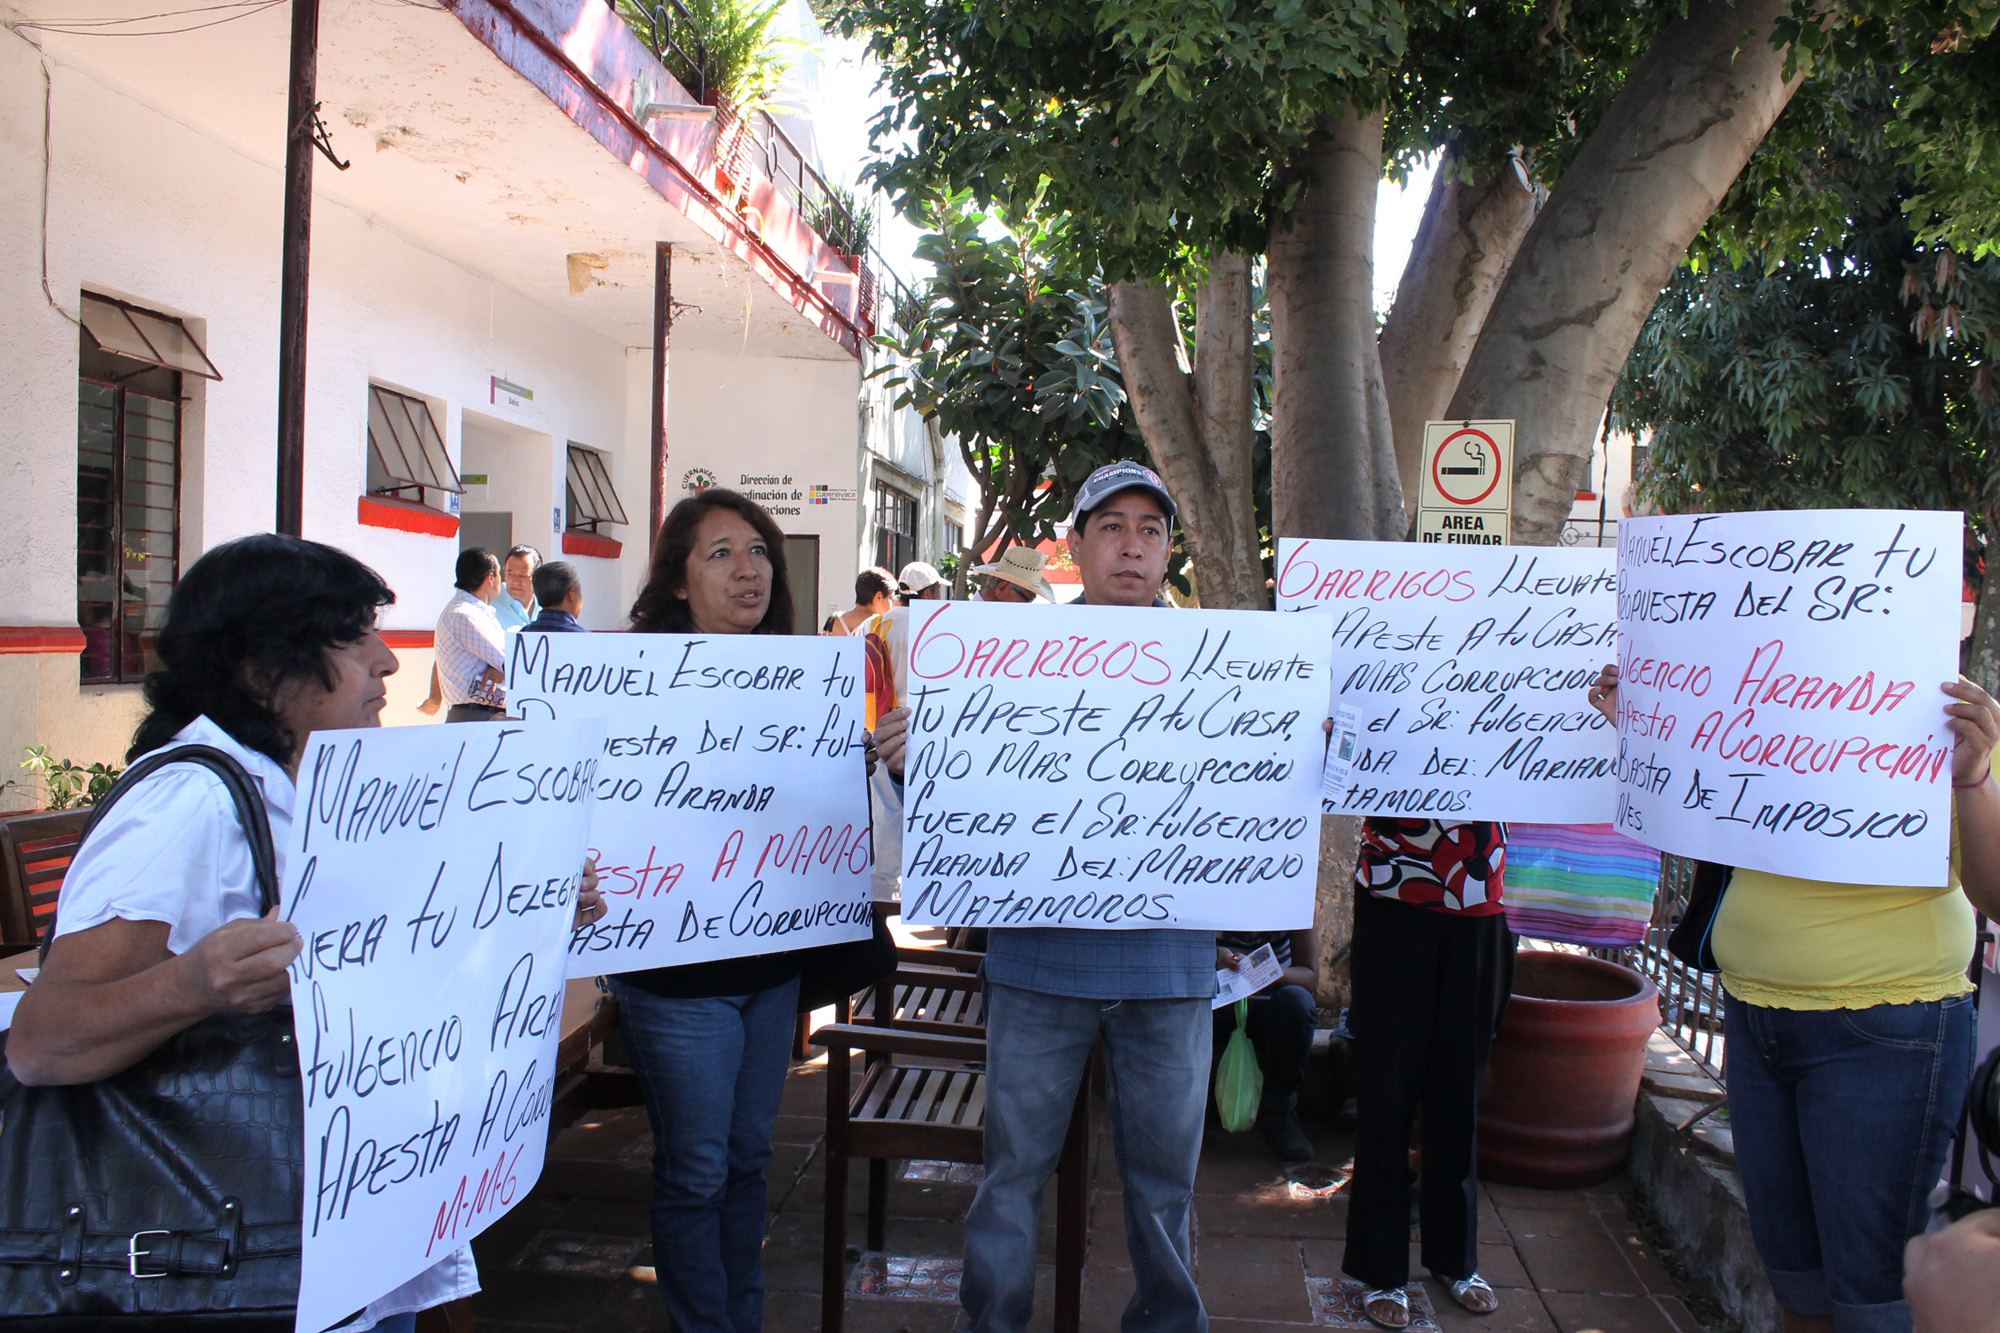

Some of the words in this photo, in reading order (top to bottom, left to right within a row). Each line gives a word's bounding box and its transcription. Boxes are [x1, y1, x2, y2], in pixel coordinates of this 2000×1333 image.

[682, 467, 718, 490] CUERNAVACA
[740, 474, 779, 485] Dirección
[782, 475, 792, 485] de
[791, 489, 803, 500] de
[1423, 532, 1442, 543] DE
[1447, 533, 1503, 546] FUMAR
[1442, 515, 1484, 531] AREA
[1674, 516, 1855, 574] ESCOBAR
[1278, 540, 1476, 602] GARRIGOS
[1617, 568, 1717, 624] PROPUESTA
[1734, 580, 1793, 618] DEL
[910, 603, 1172, 686] GARRIGOS
[1332, 606, 1445, 652] APESTE
[1456, 617, 1496, 656] A
[509, 634, 659, 696] MANUÉL
[669, 640, 805, 691] ESCOBAR
[1340, 659, 1418, 695] MAS
[1733, 639, 1916, 716] ARANDA
[951, 684, 1112, 738] APESTE
[1119, 693, 1165, 738] A
[1691, 710, 1723, 752] A
[908, 737, 972, 787] NO
[986, 740, 1072, 783] MAS
[1485, 736, 1617, 781] MARIAN
[303, 738, 465, 853] MANUÉL
[467, 729, 598, 812] ESCOBAR
[654, 761, 776, 812] ARANDA
[907, 780, 1017, 836] FUERA
[1617, 737, 1671, 795] BASTA
[1683, 769, 1718, 809] DE
[1715, 773, 1928, 839] IMPOSICIO
[712, 829, 744, 882] A
[907, 834, 1031, 879] ARANDA
[1127, 843, 1304, 886] MARIANO
[568, 908, 654, 955] ASTA
[675, 900, 724, 943] DE
[312, 1099, 460, 1237] APESTA
[472, 1070, 507, 1157] A
